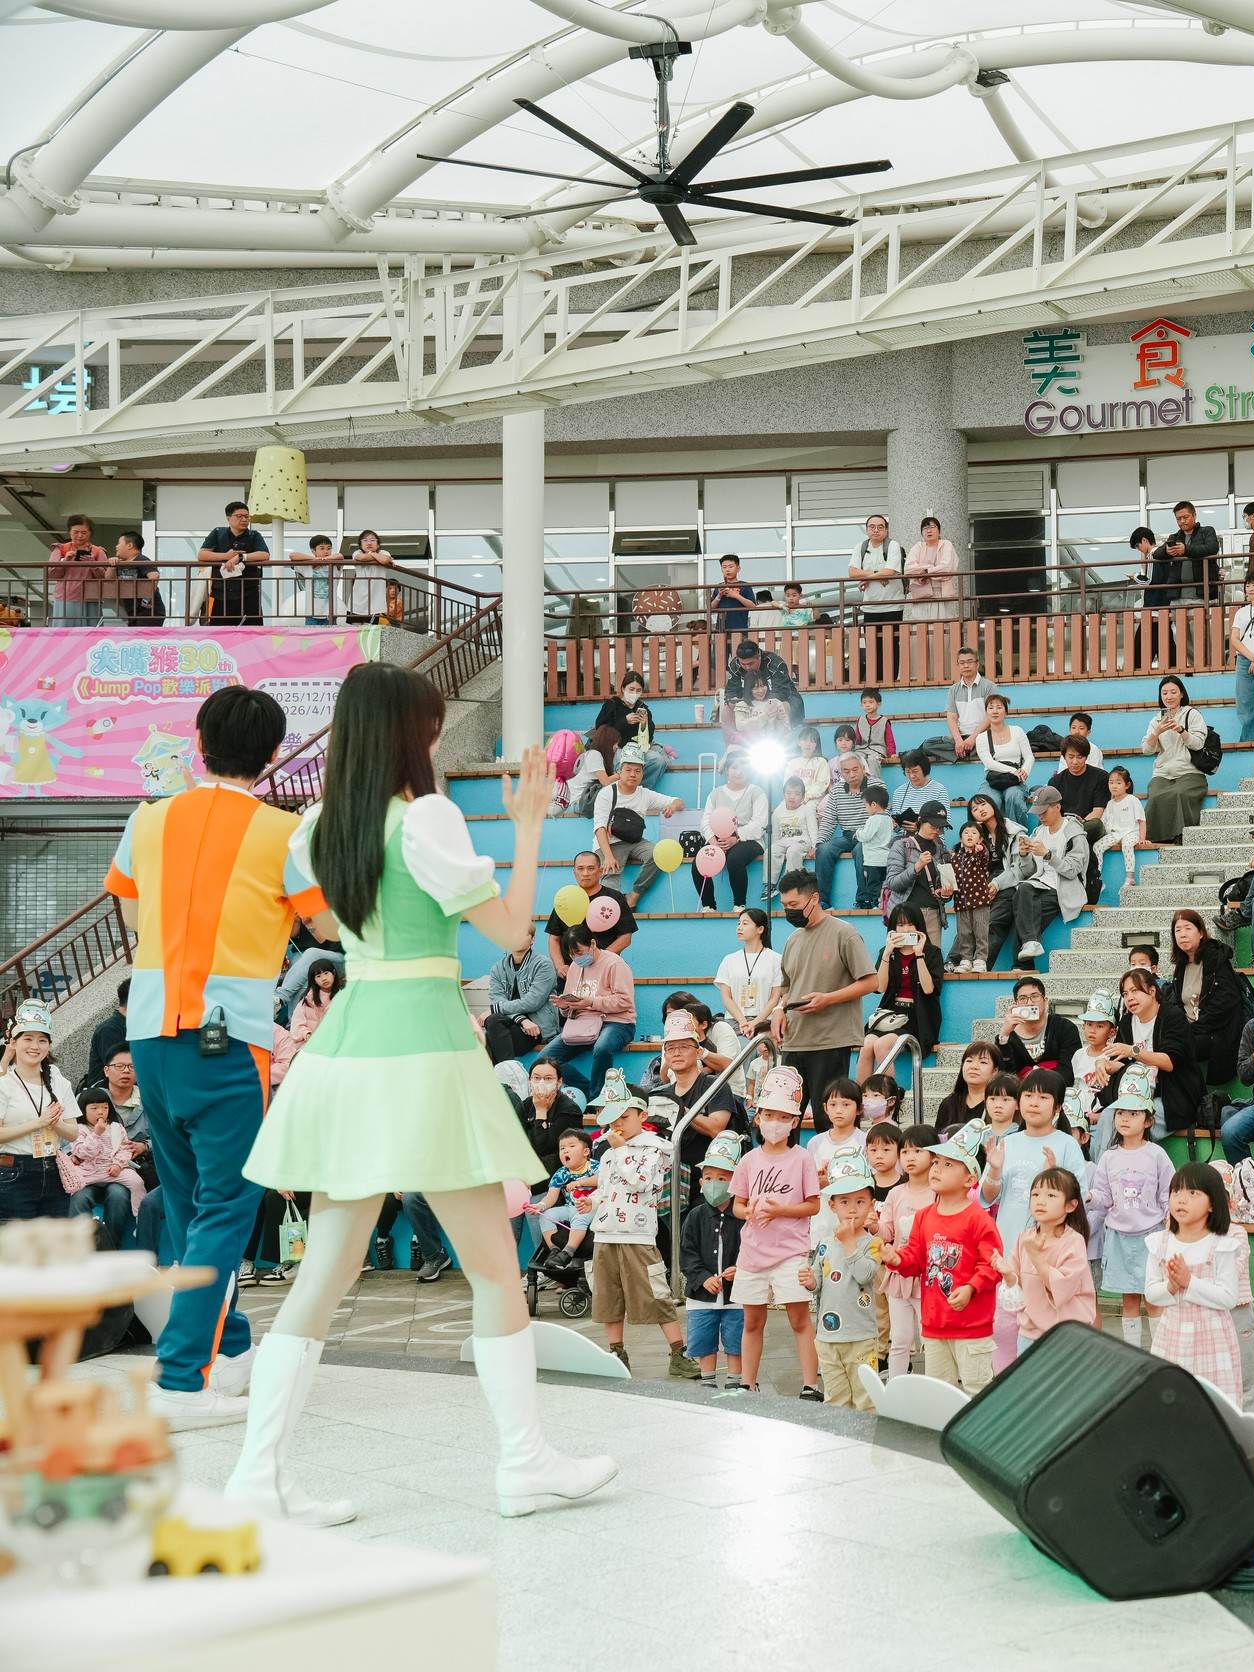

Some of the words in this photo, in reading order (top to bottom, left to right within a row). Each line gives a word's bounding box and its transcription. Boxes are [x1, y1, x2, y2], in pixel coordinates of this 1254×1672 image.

[1024, 388, 1194, 436] Gourmet
[750, 1166, 794, 1196] Nike
[626, 1192, 639, 1204] 73
